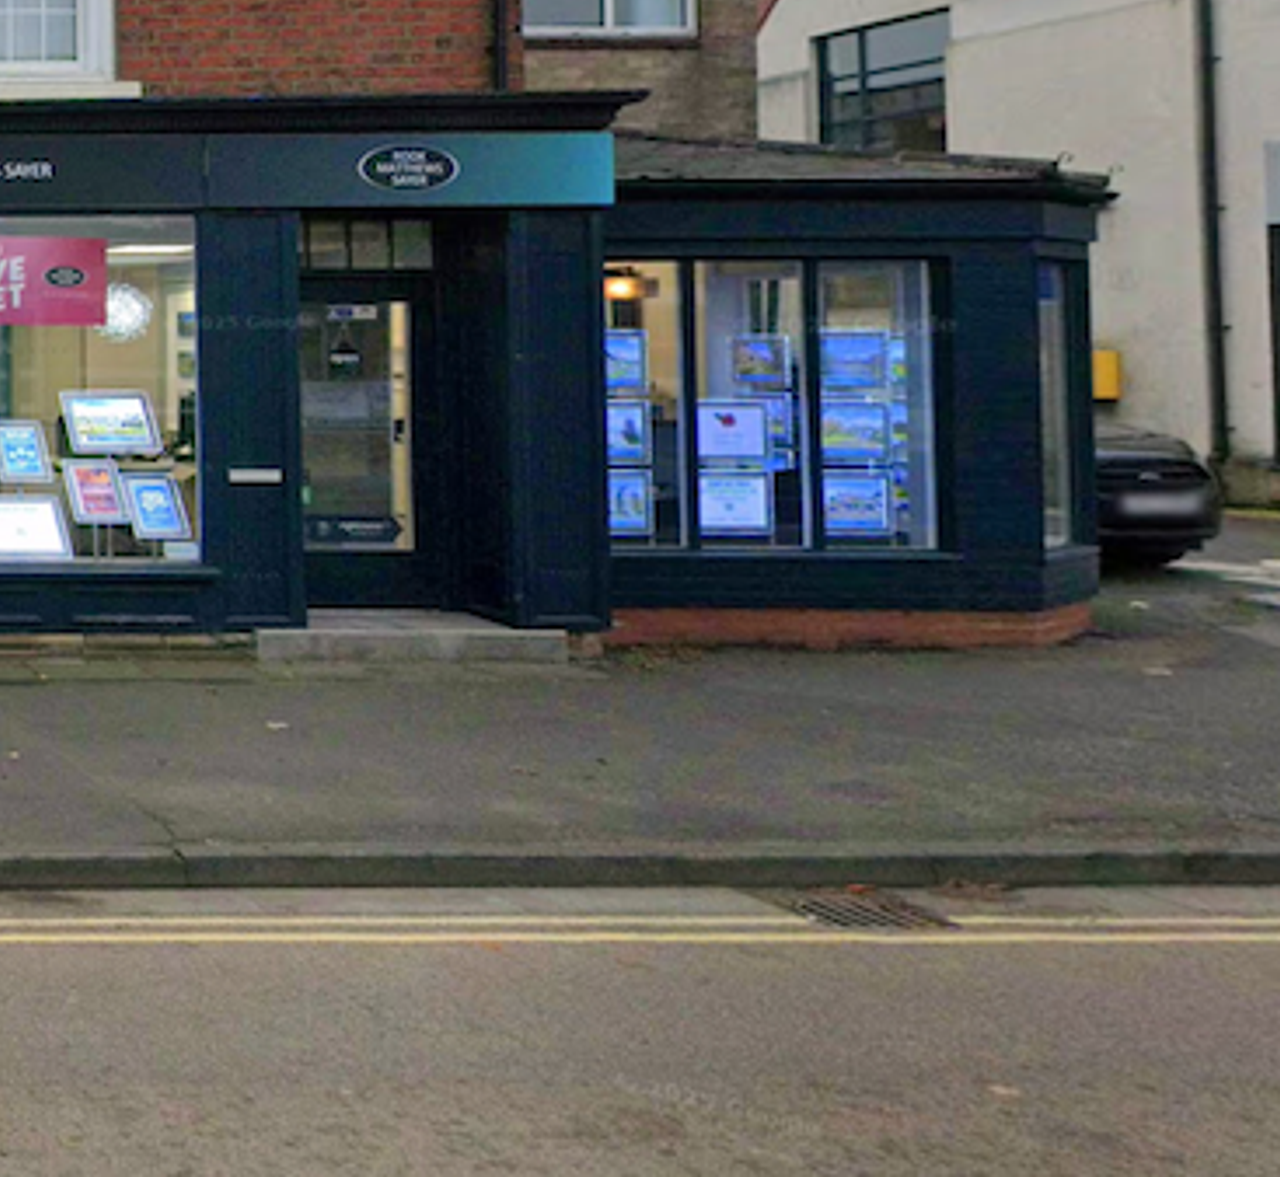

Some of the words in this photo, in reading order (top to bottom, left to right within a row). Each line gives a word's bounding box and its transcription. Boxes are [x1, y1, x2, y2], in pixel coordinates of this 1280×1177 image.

[393, 151, 425, 162] ROOK
[3, 163, 53, 178] SAYER
[376, 162, 443, 174] MATTHEWS
